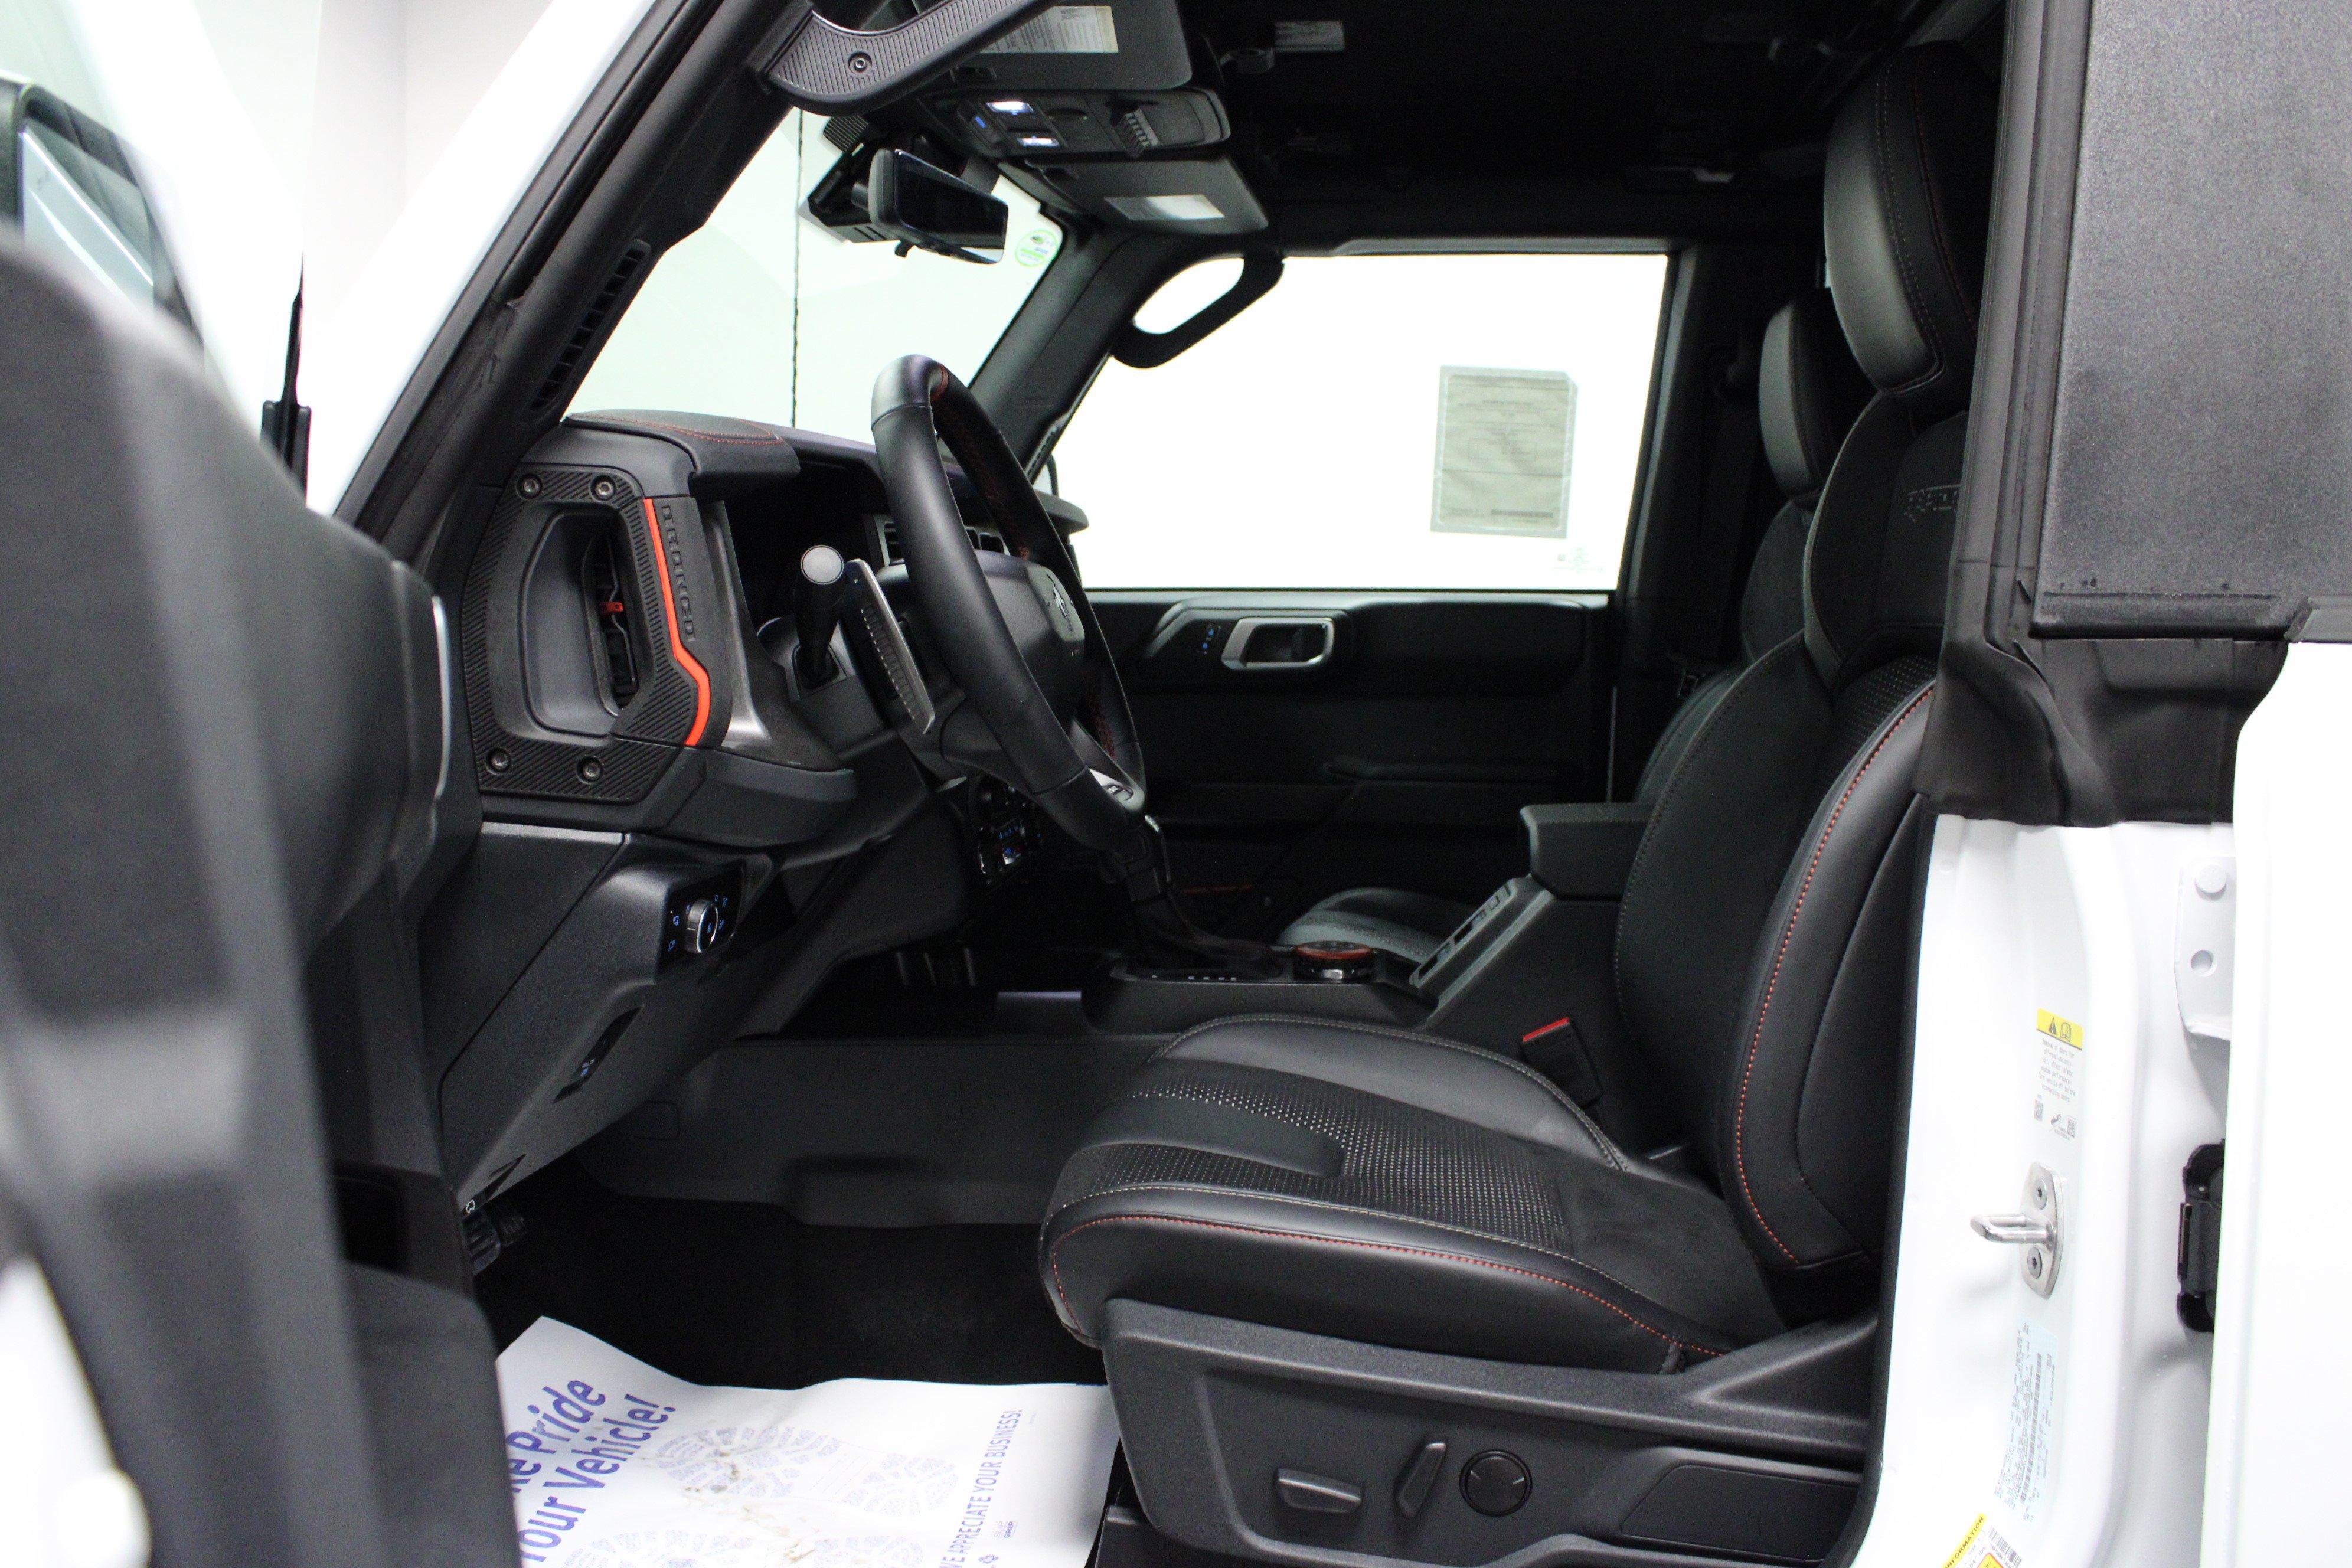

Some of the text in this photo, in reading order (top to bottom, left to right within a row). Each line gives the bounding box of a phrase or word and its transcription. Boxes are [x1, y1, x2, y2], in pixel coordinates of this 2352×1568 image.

[662, 506, 696, 641] BRONCO
[505, 1380, 606, 1455] Pride
[542, 1393, 676, 1488] Vehicle!
[984, 1409, 1023, 1458] BUSINESS!
[972, 1461, 1002, 1493] YOUR
[947, 1496, 992, 1554] APPRECIATE
[1004, 1520, 1014, 1538] GRIP
